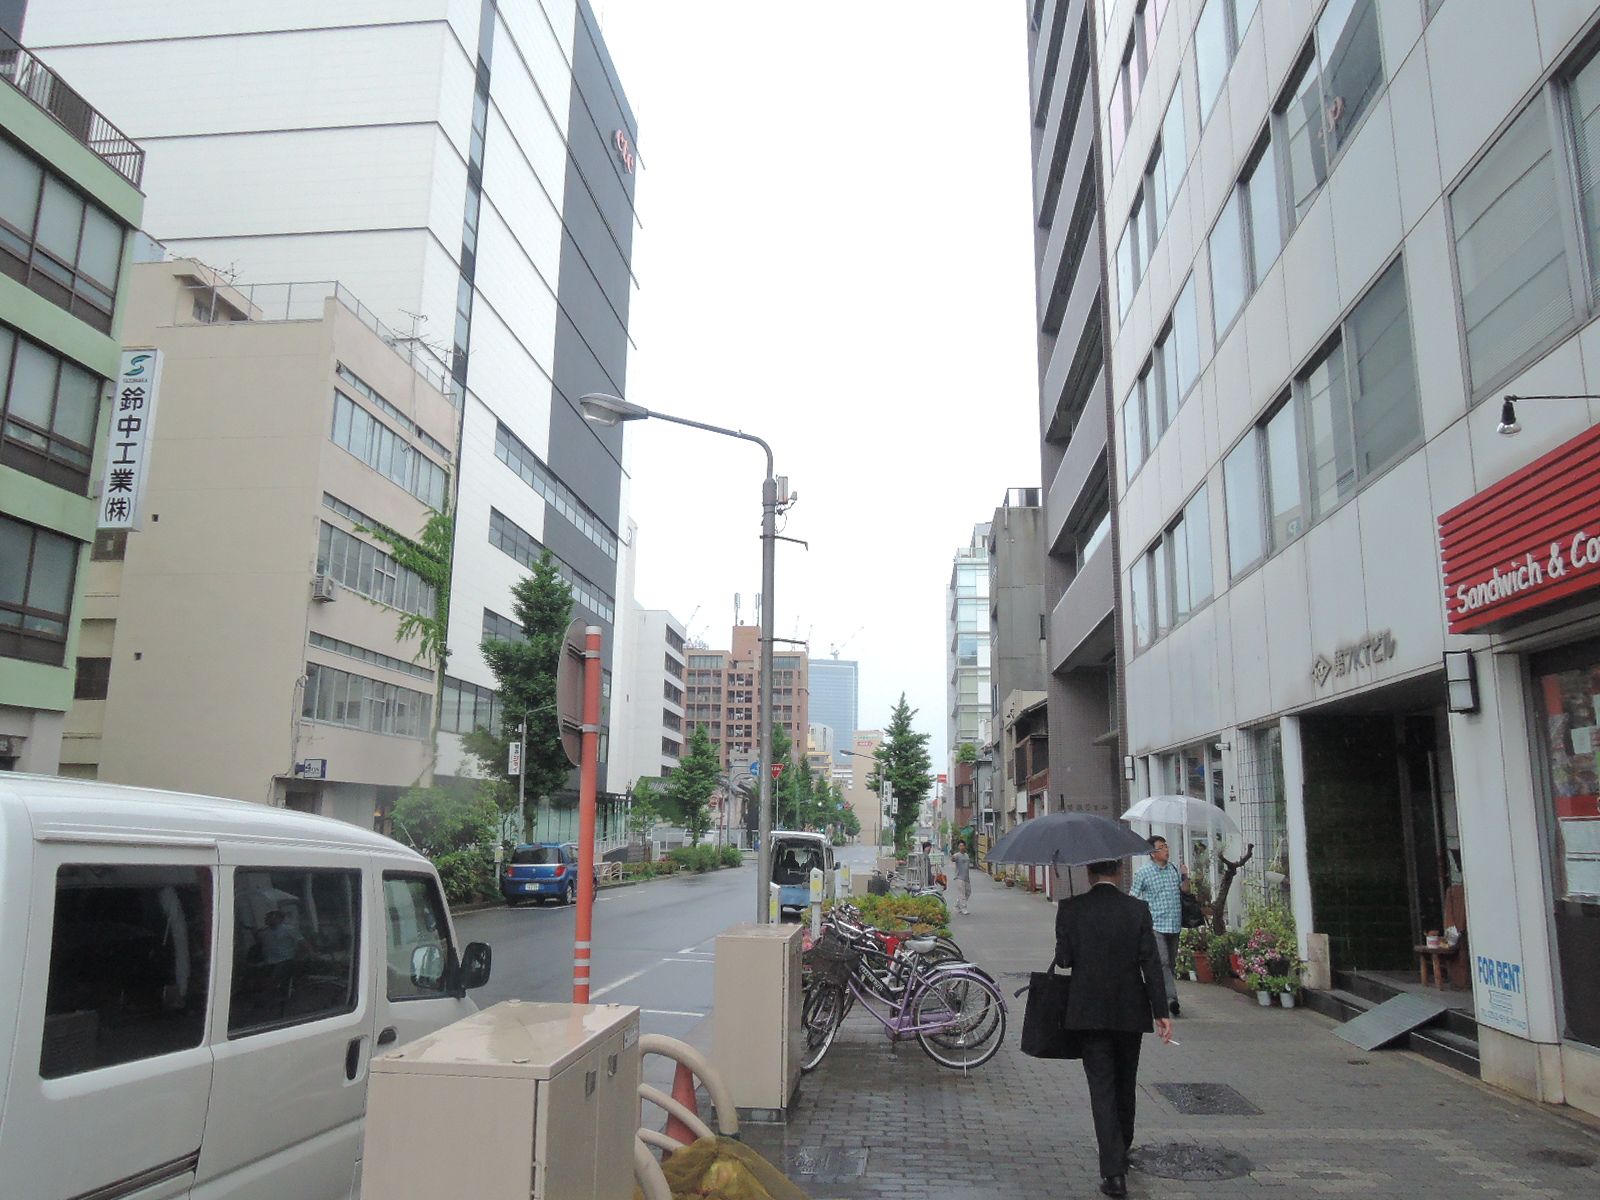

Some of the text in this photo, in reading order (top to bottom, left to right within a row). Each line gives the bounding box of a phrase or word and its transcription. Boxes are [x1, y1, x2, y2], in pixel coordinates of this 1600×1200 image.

[1456, 531, 1600, 614] Sandwich & Co
[1477, 955, 1521, 994] FOR RENT
